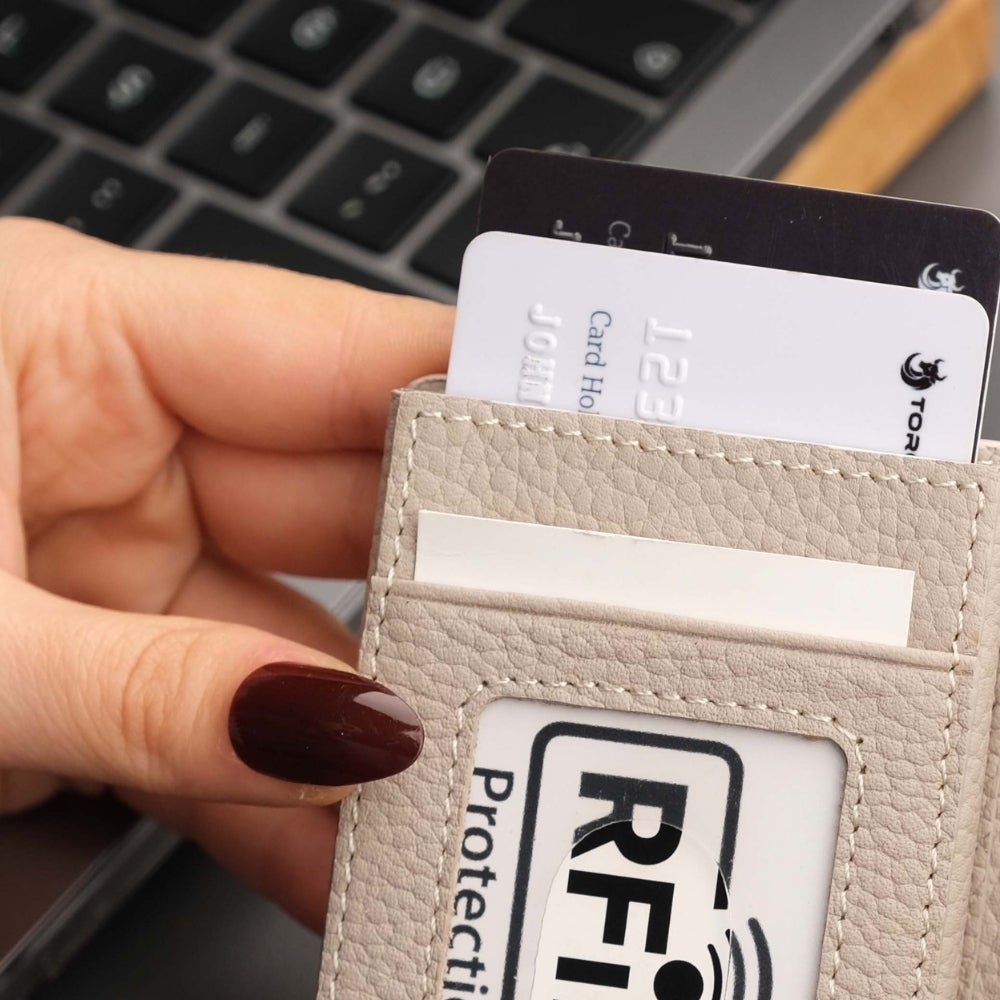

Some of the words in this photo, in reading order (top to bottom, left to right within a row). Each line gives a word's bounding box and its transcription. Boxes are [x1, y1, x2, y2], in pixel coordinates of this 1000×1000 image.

[517, 302, 562, 404] JOHN
[584, 310, 612, 367] Card
[635, 316, 693, 422] 123
[904, 396, 926, 456] TOR
